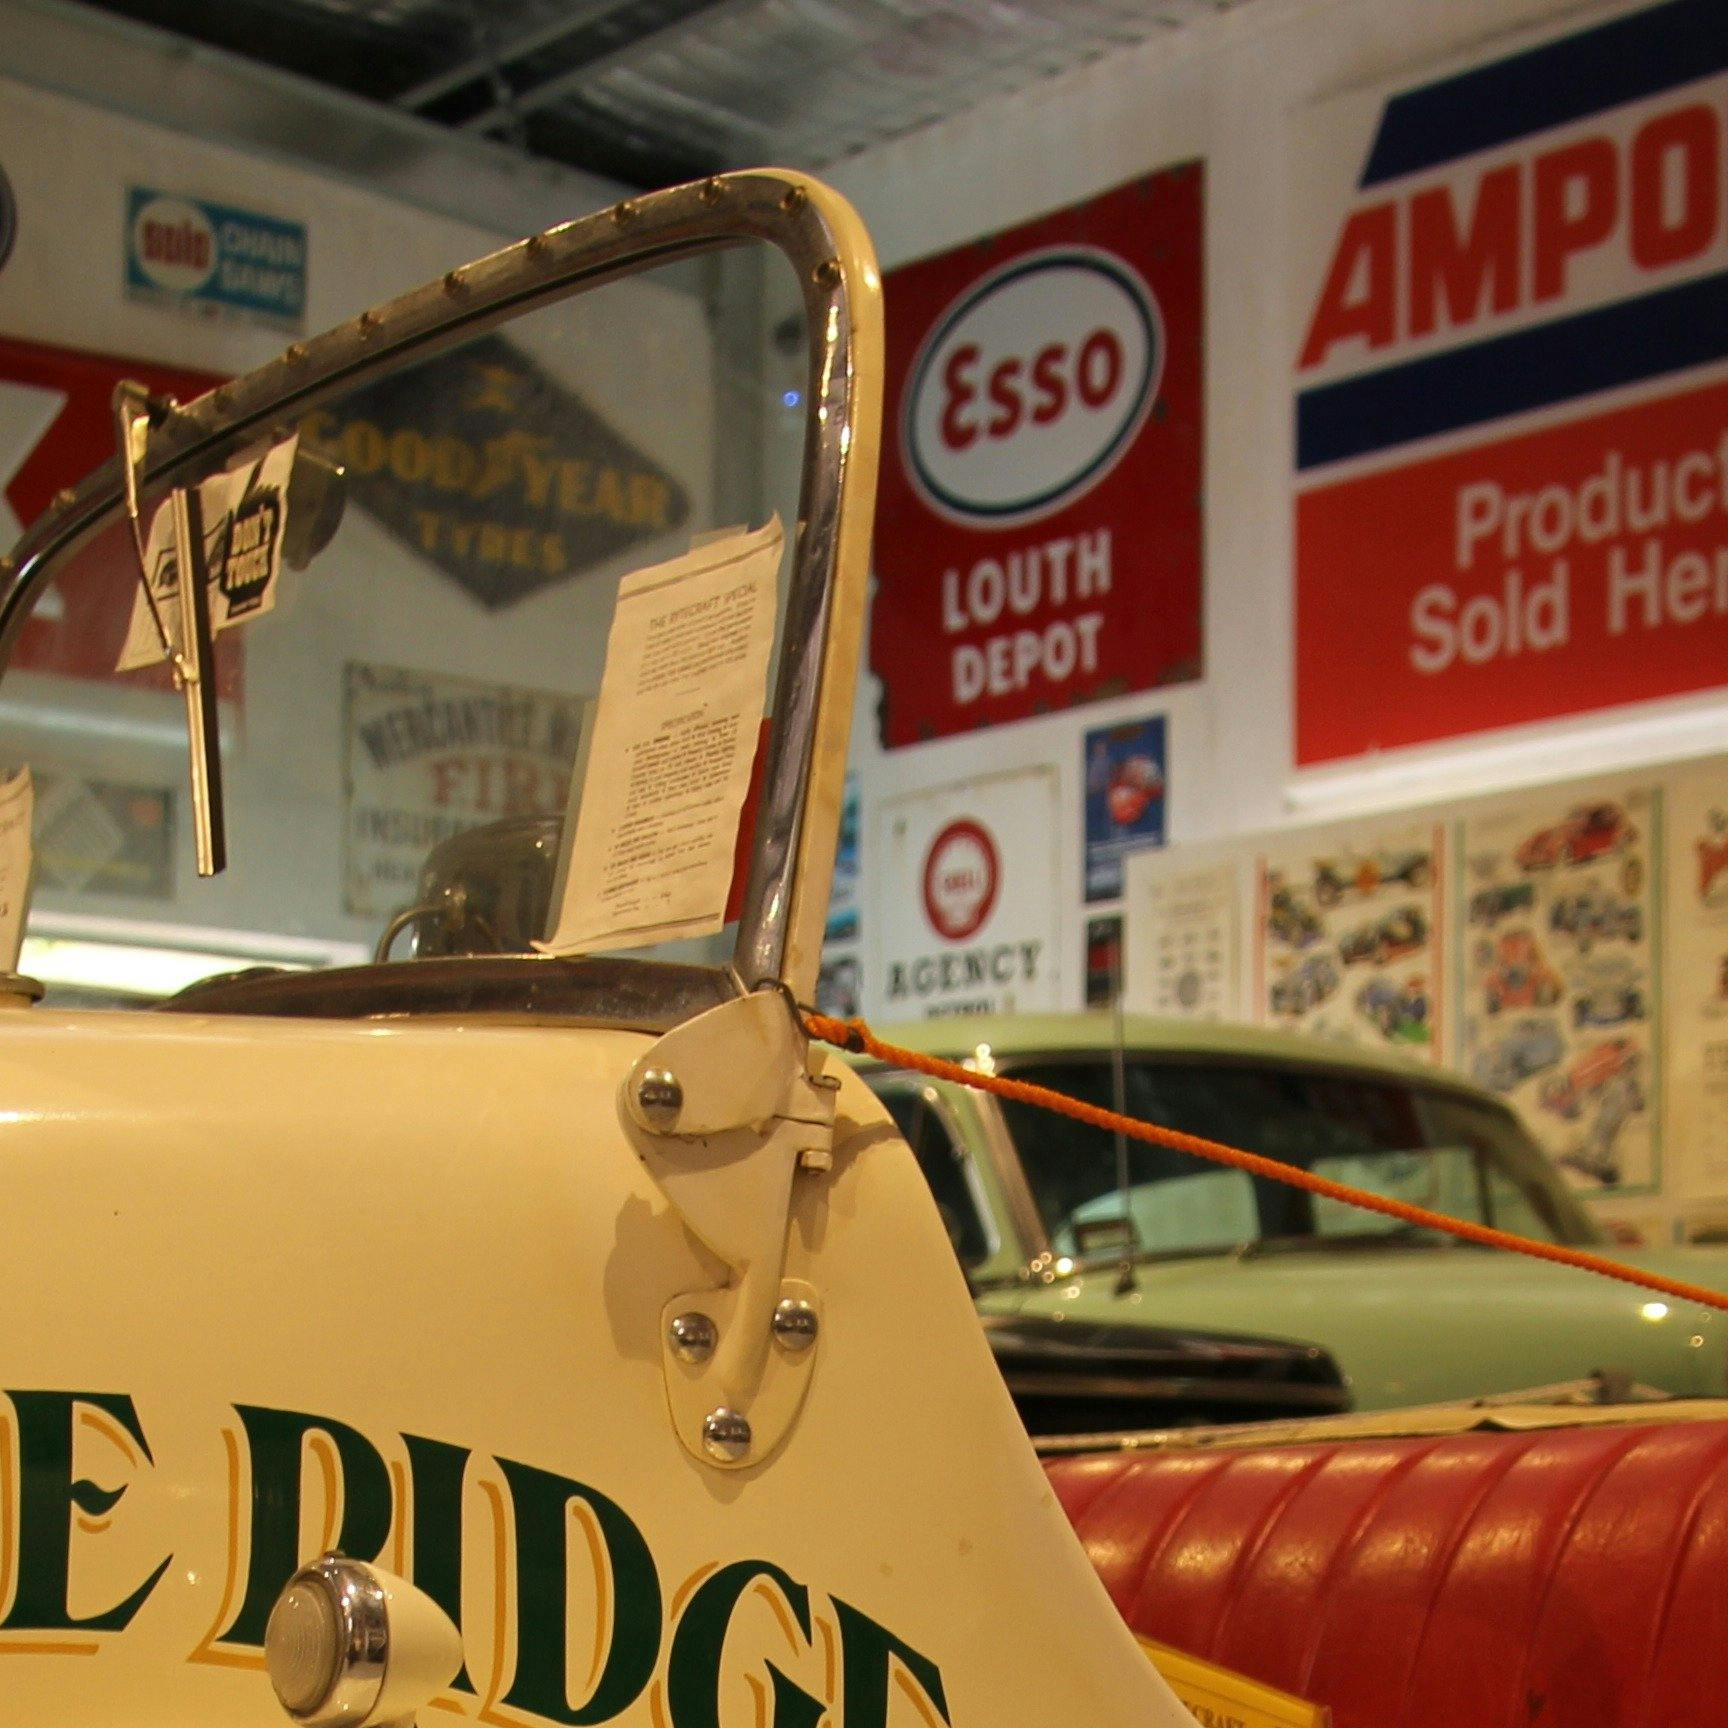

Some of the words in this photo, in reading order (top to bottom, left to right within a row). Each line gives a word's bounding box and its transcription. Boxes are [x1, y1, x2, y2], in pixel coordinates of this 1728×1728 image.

[941, 527, 1114, 634] LOUTH
[1409, 560, 1569, 675] Sold
[951, 613, 1104, 704] DEPOT
[886, 941, 1040, 1001] AGENCY
